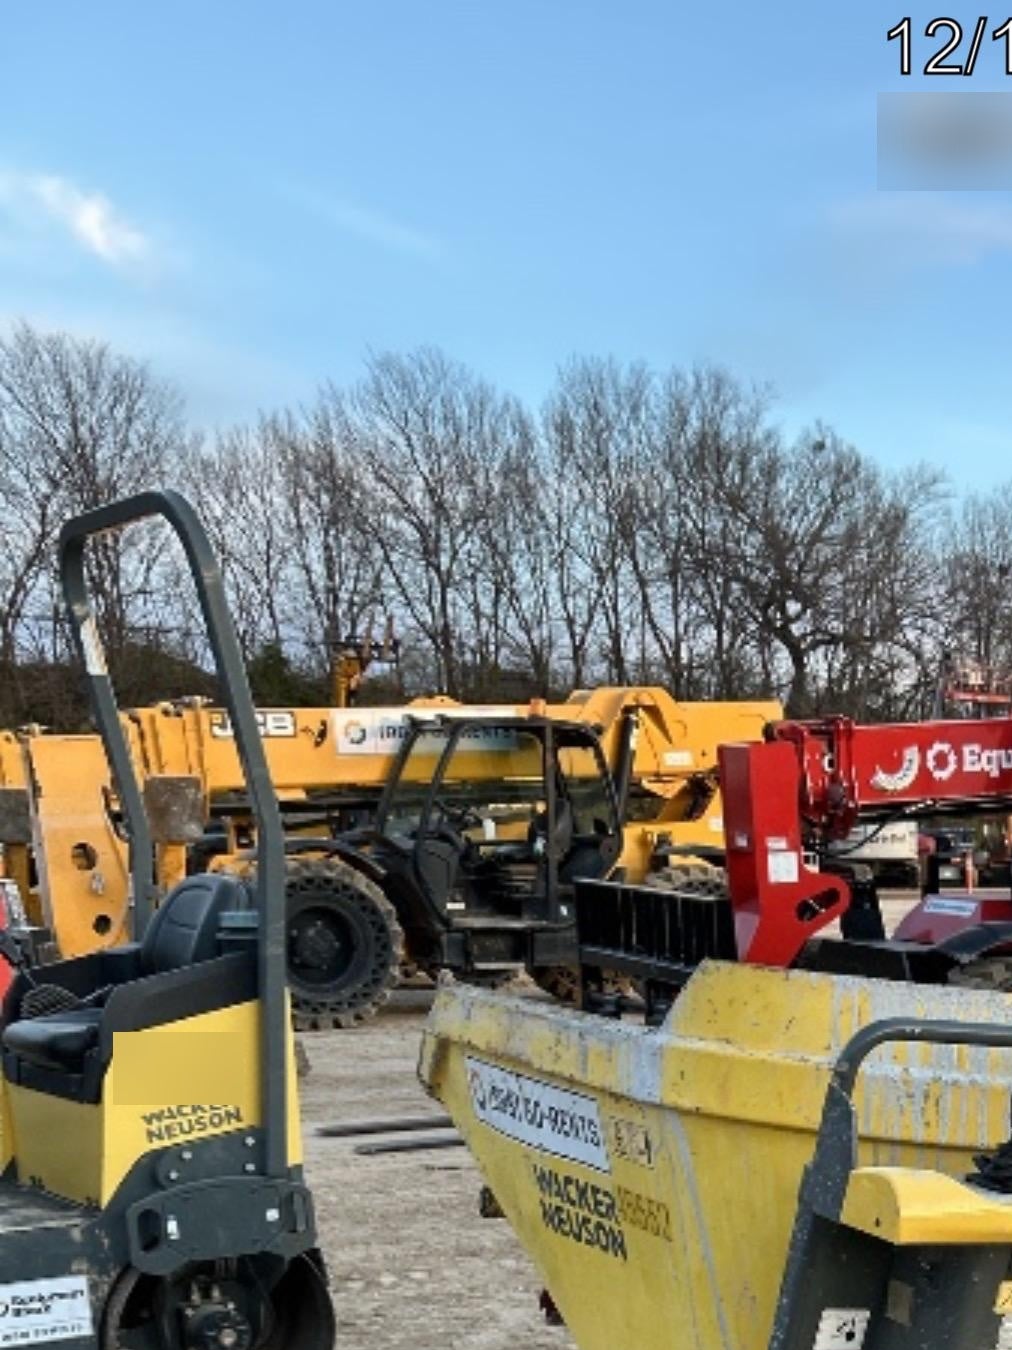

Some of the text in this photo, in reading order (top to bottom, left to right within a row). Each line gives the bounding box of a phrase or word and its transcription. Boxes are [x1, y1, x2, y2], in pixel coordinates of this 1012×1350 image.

[146, 1107, 242, 1143] NEUSON
[532, 1162, 622, 1226] WACKER
[540, 1197, 629, 1262] NEUSON
